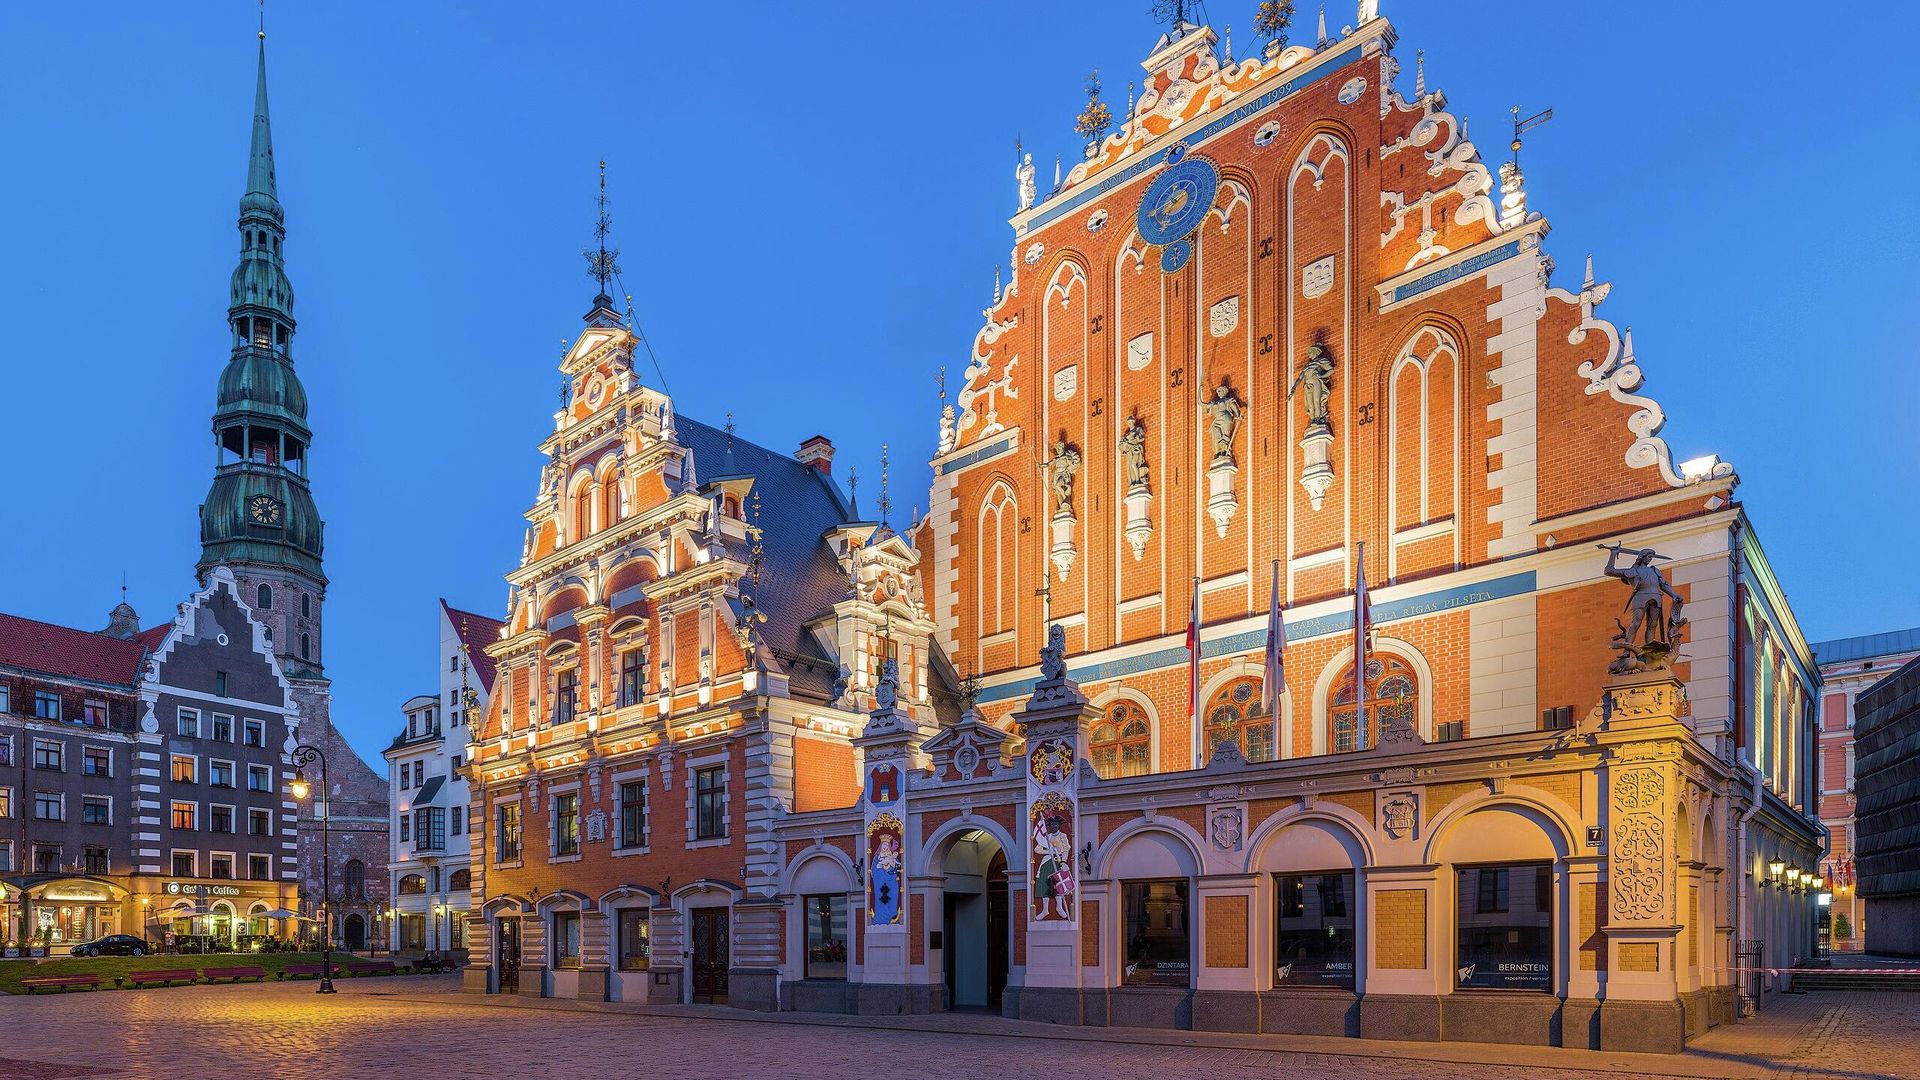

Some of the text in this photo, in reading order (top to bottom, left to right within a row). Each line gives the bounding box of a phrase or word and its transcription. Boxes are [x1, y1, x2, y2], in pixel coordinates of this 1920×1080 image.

[1231, 98, 1262, 123] ANNO
[1267, 82, 1293, 105] 1999
[1296, 628, 1311, 639] NO
[1592, 830, 1599, 839] 7
[212, 885, 240, 896] Coffee
[1325, 962, 1353, 970] AMBER
[1498, 963, 1549, 972] BERNSTEIN
